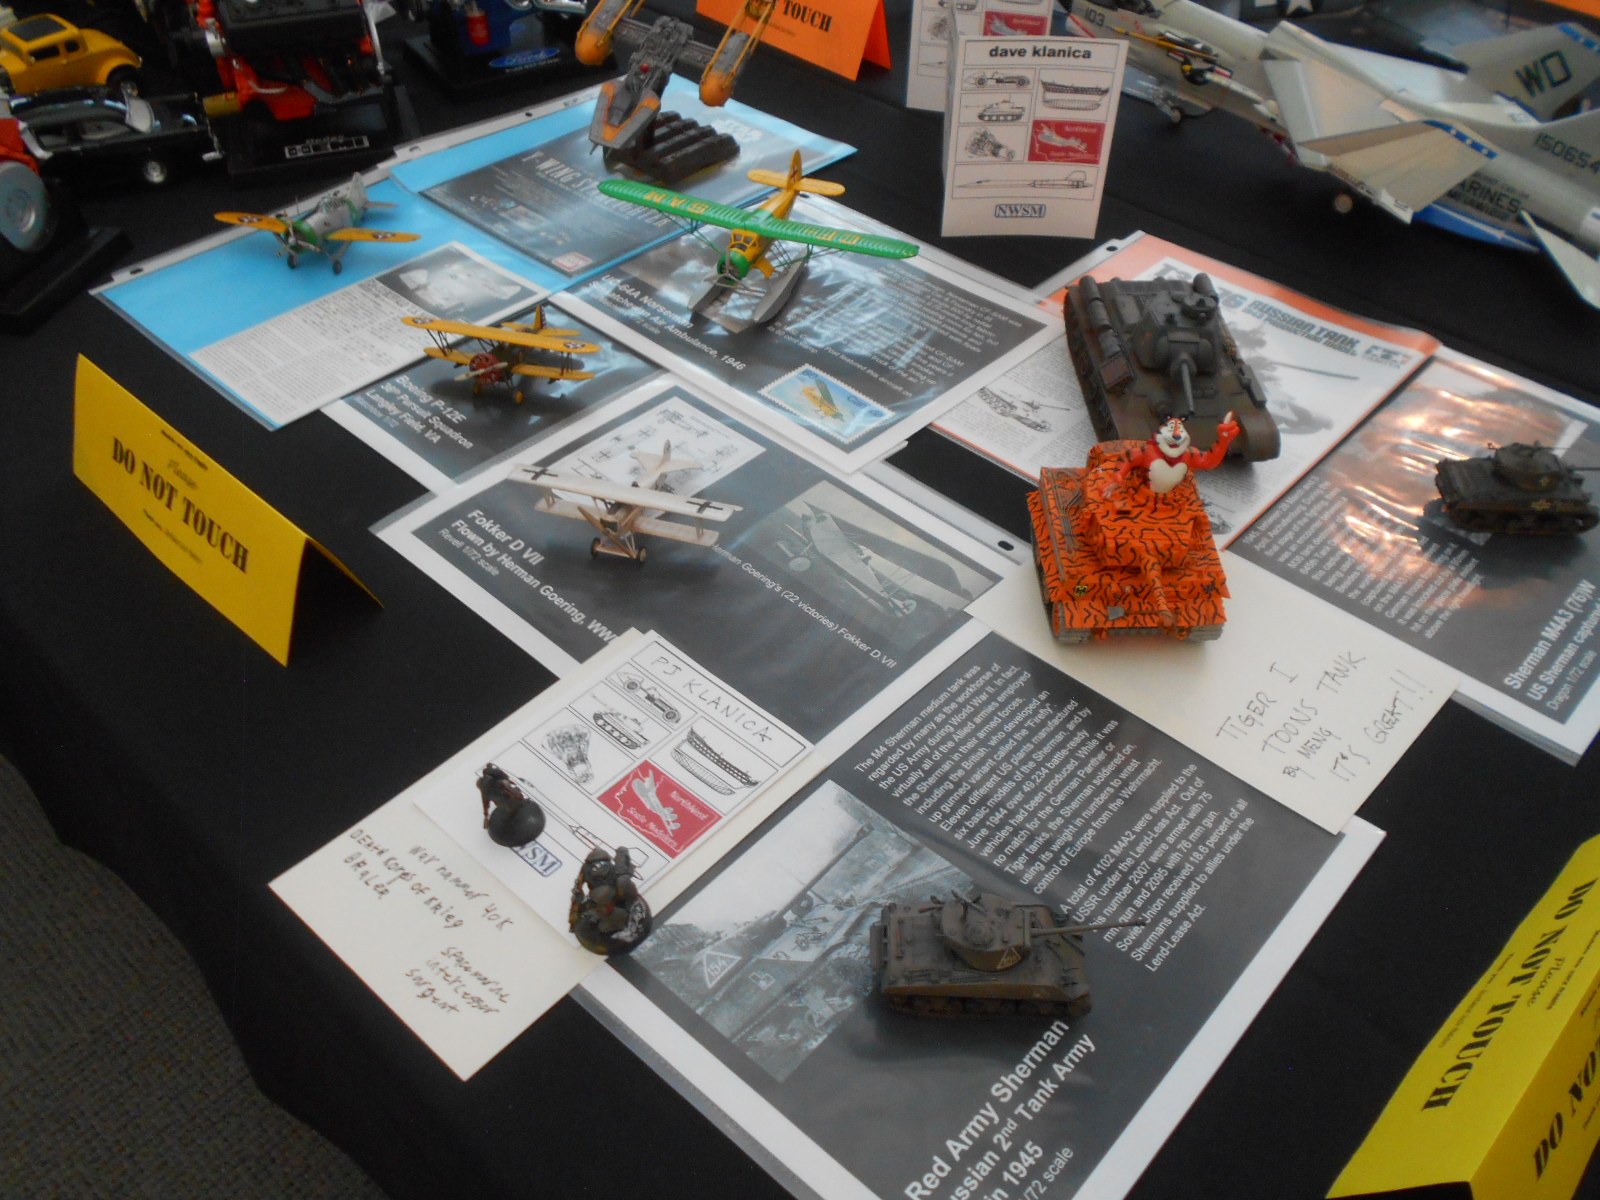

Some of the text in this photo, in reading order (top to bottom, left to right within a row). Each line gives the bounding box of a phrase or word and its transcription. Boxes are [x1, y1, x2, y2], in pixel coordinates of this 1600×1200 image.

[782, 0, 833, 33] TOUCH
[1085, 7, 1106, 27] 103
[989, 46, 1092, 59] dave klanica
[1515, 50, 1573, 98] WD
[998, 204, 1044, 217] NWSM
[638, 293, 694, 330] Norseman
[648, 315, 668, 326] Air
[665, 323, 718, 358] Ambulance,
[720, 353, 747, 371] 1946
[396, 374, 436, 406] Boeing
[431, 393, 467, 425] P-12E
[424, 428, 442, 445] VA
[428, 414, 474, 450] Squadron
[112, 436, 136, 475] DO
[141, 461, 178, 511] NOT
[182, 495, 250, 575] TOUCH
[467, 508, 546, 567] Fokker D VII
[450, 519, 485, 548] Flown
[482, 540, 501, 558] by
[496, 552, 541, 588] Herman
[538, 584, 588, 624] Goering,
[741, 561, 782, 593] Goering's
[780, 588, 801, 604] (22
[797, 600, 841, 632] victories)
[837, 626, 872, 652] Fokker
[869, 648, 897, 669] D.VII
[1503, 578, 1597, 690] Sherman M4A3 (76)W
[650, 655, 773, 743] PJ KLANICA
[1216, 661, 1298, 740] TIGER I
[1526, 681, 1549, 701] US
[1538, 641, 1580, 685] Sherman
[854, 665, 980, 771] The M4 Sherman medium tank was
[1261, 651, 1367, 754] TOONS TANK
[878, 776, 895, 789] the
[891, 763, 908, 775] US
[906, 745, 929, 764] Army
[928, 725, 953, 745] during
[949, 705, 973, 724] World
[970, 692, 988, 705] War
[1297, 726, 1342, 760] MENG
[518, 841, 557, 876] SM
[1034, 864, 1061, 893] control
[1059, 854, 1069, 865] of
[1065, 828, 1095, 856] Europe
[1091, 811, 1112, 828] from
[1108, 798, 1123, 811] the
[1059, 764, 1196, 913] A total of 4102 M4A2 were supplied to the
[1131, 818, 1253, 960] Shermans supplied to allies under the
[1553, 876, 1599, 920] DO
[1145, 921, 1191, 970] Lend-Lease
[1506, 924, 1568, 987] NOT
[1421, 994, 1523, 1112] TOUCH
[904, 1155, 952, 1200] Red
[945, 1101, 1000, 1162] Army
[990, 1019, 1070, 1104] Sherman
[949, 1149, 1001, 1200] ssian
[992, 1117, 1019, 1153] 2nd
[1013, 1077, 1060, 1122] Tank
[1051, 1033, 1096, 1081] Army
[1002, 1140, 1044, 1188] 1945
[1042, 1146, 1075, 1184] scale
[1534, 1112, 1564, 1182] DO
